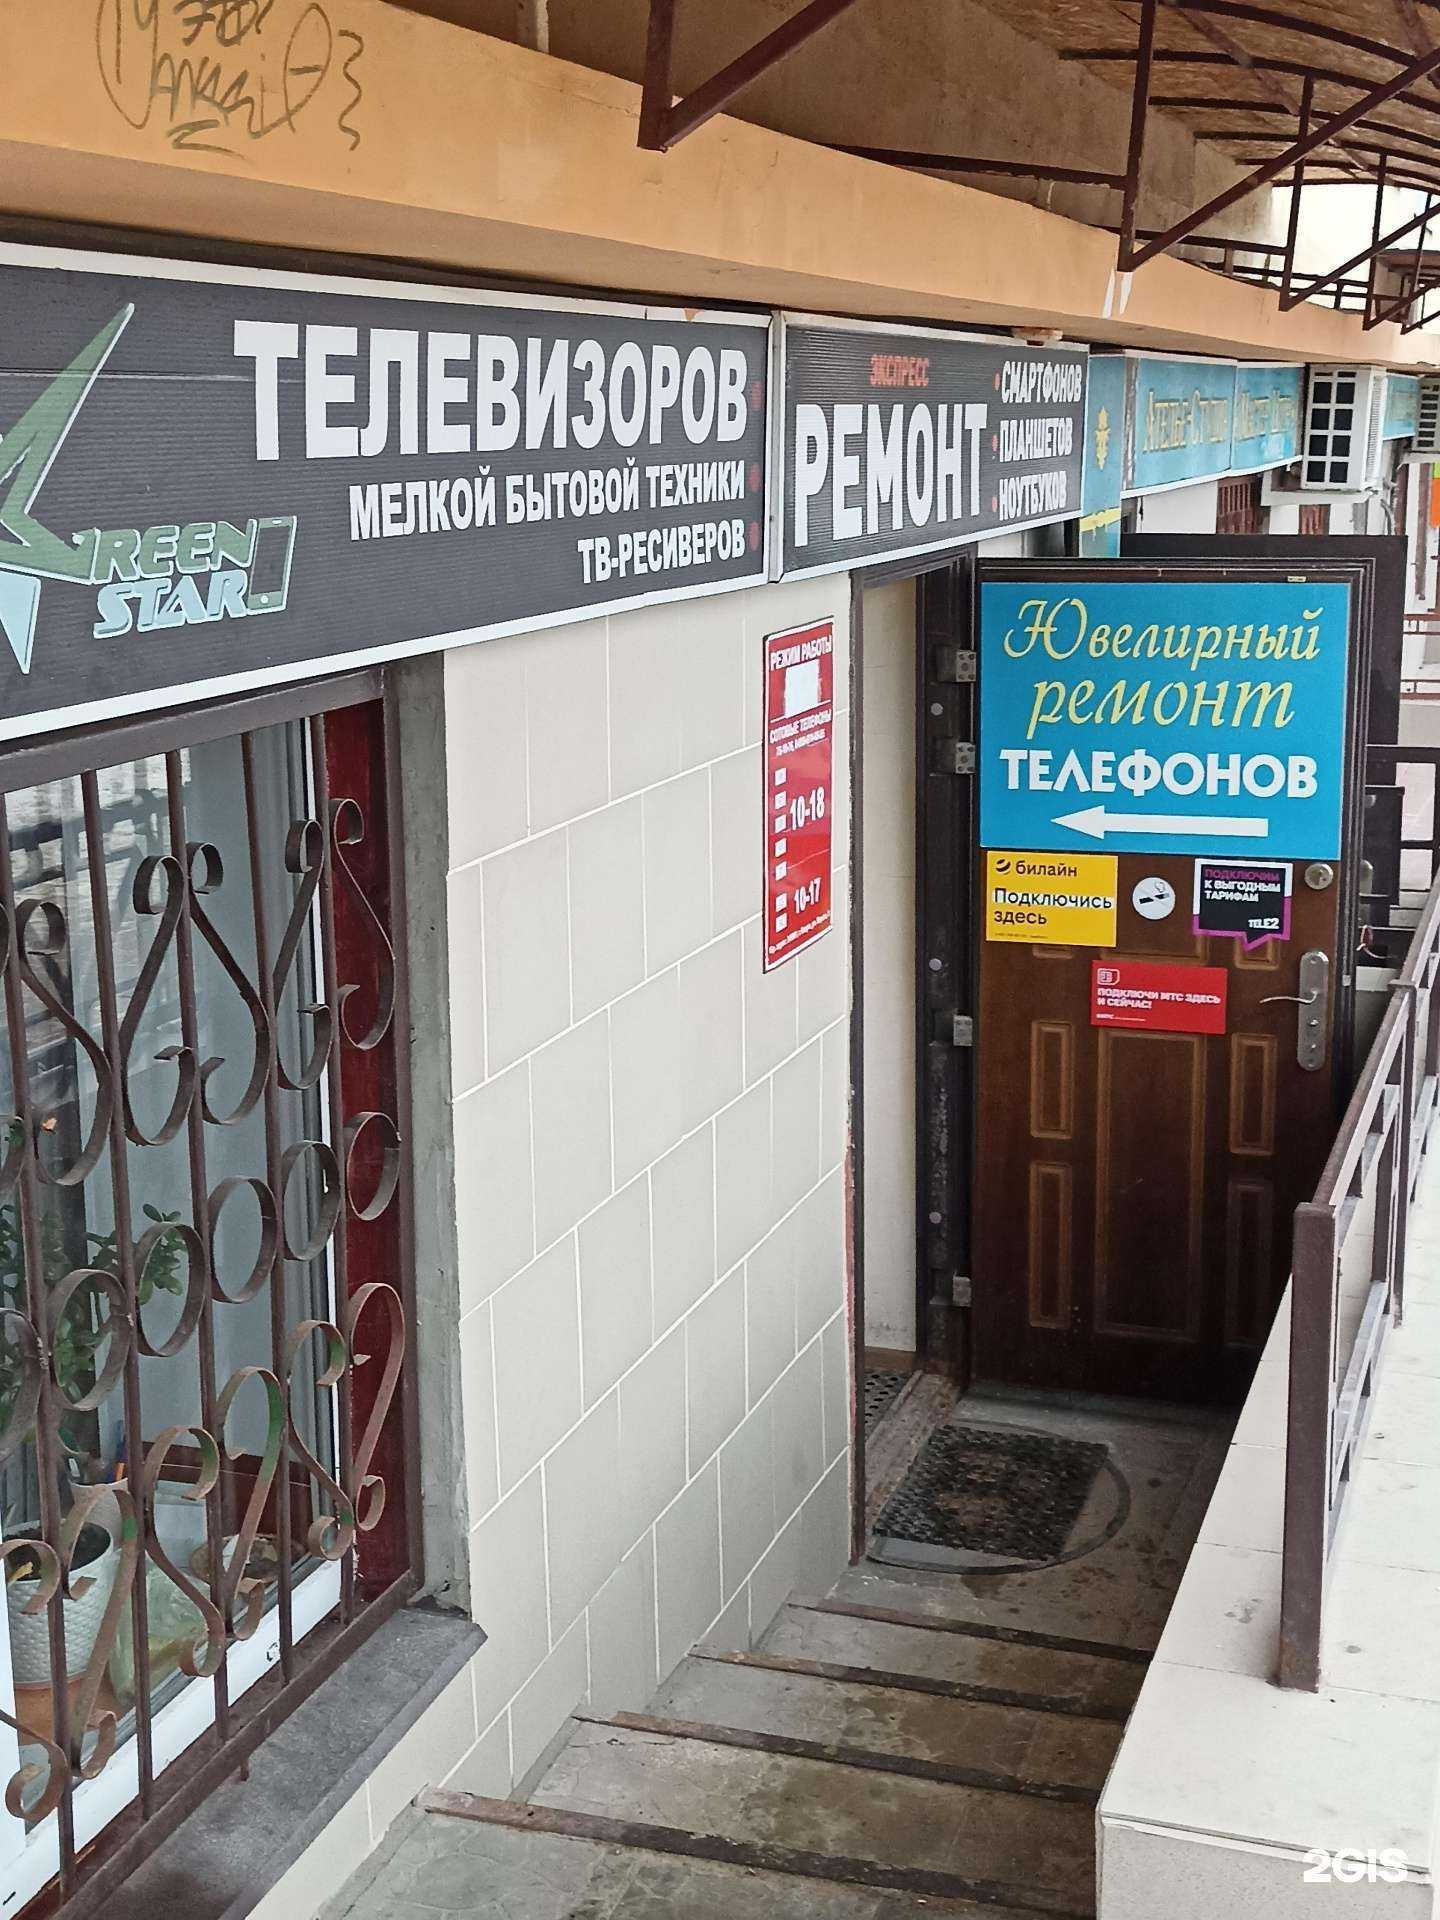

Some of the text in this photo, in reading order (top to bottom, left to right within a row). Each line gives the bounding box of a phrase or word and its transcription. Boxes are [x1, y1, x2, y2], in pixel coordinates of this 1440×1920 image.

[234, 320, 748, 461] ТЕЛЕВИЗОРОВ
[1001, 360, 1083, 403] СМАРТФОНОВ
[999, 417, 1073, 463] ПЛАНШЕТОВ
[794, 403, 988, 547] РЕМОНТ
[999, 471, 1067, 521] НОУТБУКОВ
[349, 457, 746, 541] МЕЛКОЙ БЫТОВОЙ ТЕХНИКИ
[578, 518, 746, 584] ТВ-РЕСИВЕРОВ
[93, 569, 250, 639] STAR
[770, 635, 832, 671] РЕЖИМ РАБОТЫ
[1003, 598, 1324, 671] Ювелирный
[1025, 679, 1295, 740] ремонт
[999, 748, 1319, 799] ТЕЛЕФОНОВ
[790, 786, 825, 831] 10-18
[1015, 860, 1078, 877] билайн
[1204, 880, 1280, 893] К ВЫГОДНЫМ
[794, 877, 821, 914] 10-17
[994, 887, 1112, 909] Подключись
[994, 910, 1047, 925] здесь
[1204, 890, 1259, 902] ТАРИФАМ
[1248, 918, 1280, 930] TELE2
[1097, 987, 1221, 1004] ПОДКЛЮЧИ МТС ЗДЕСЬ
[1106, 998, 1153, 1009] СЕЙЧАС!
